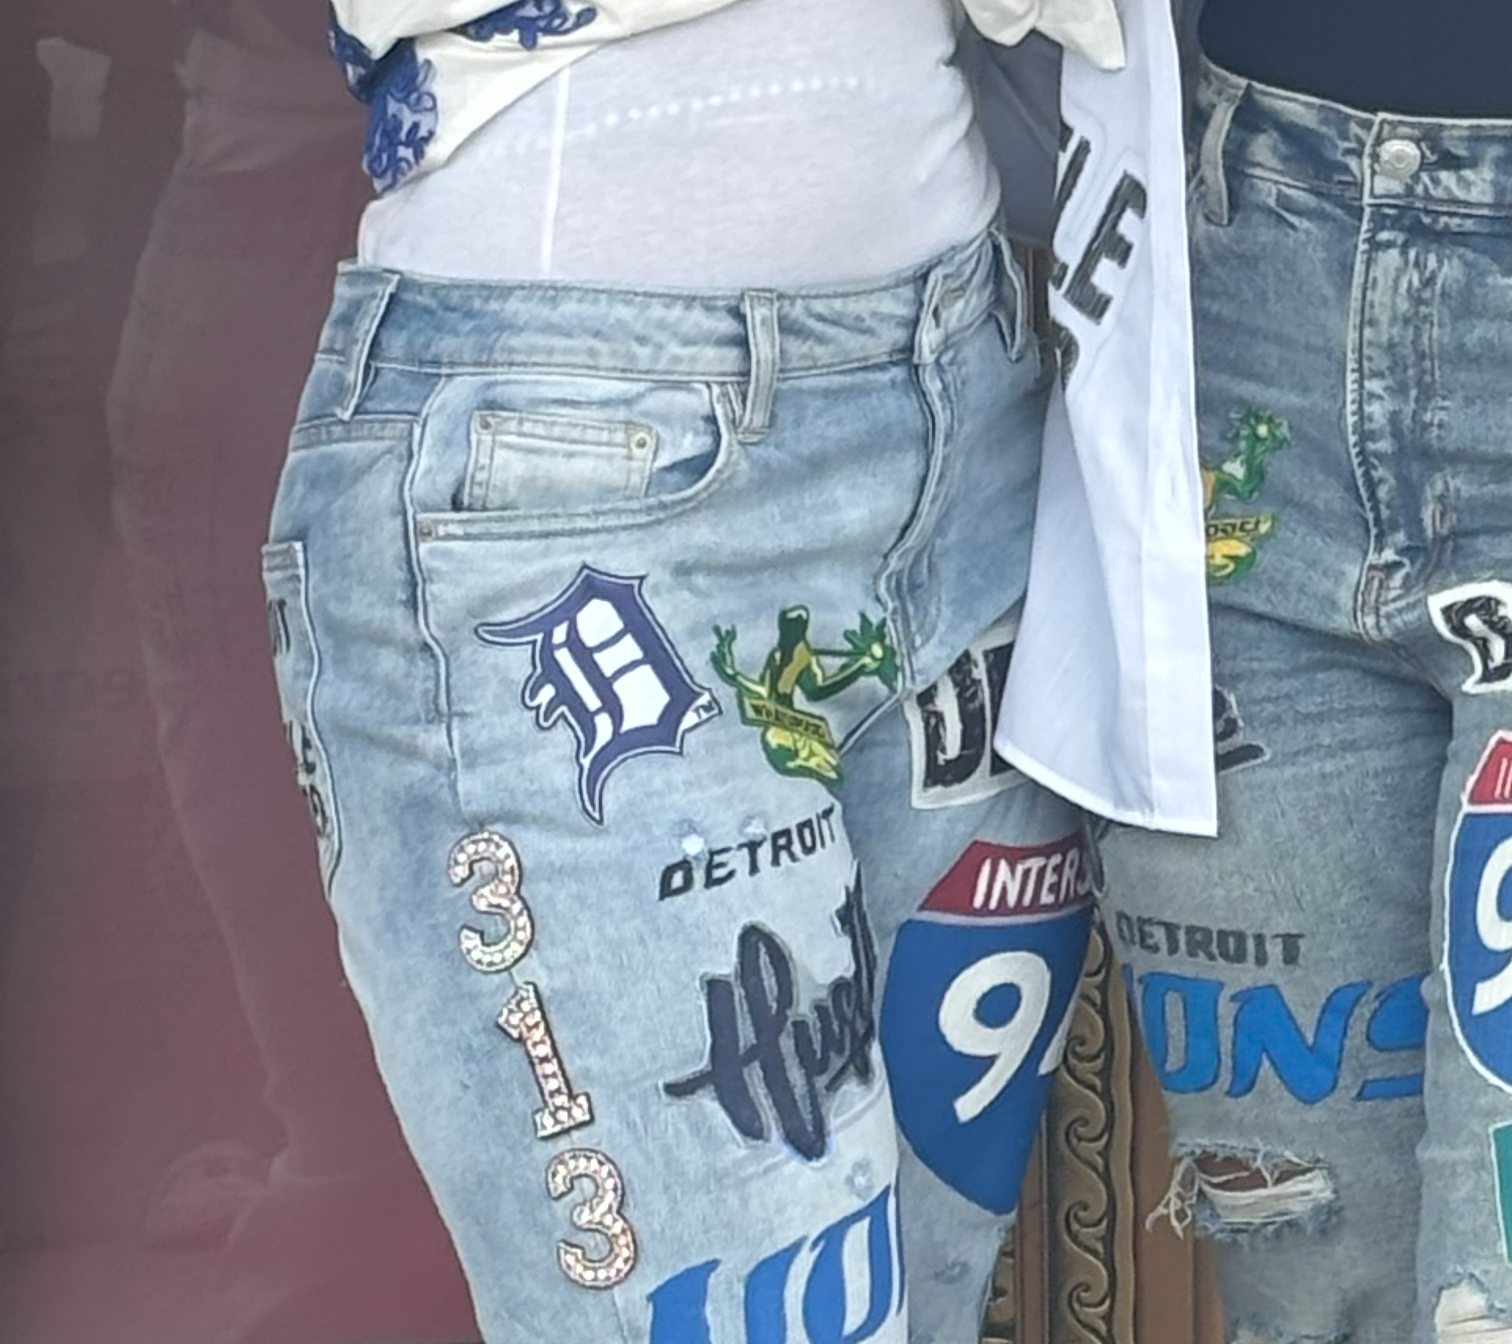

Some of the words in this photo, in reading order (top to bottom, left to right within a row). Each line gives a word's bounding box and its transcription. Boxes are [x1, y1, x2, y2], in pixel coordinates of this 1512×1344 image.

[657, 805, 836, 902] DETROIT
[1115, 910, 1306, 967] DETROIT
[937, 949, 1080, 1124] 9
[1122, 962, 1431, 1105] ONS
